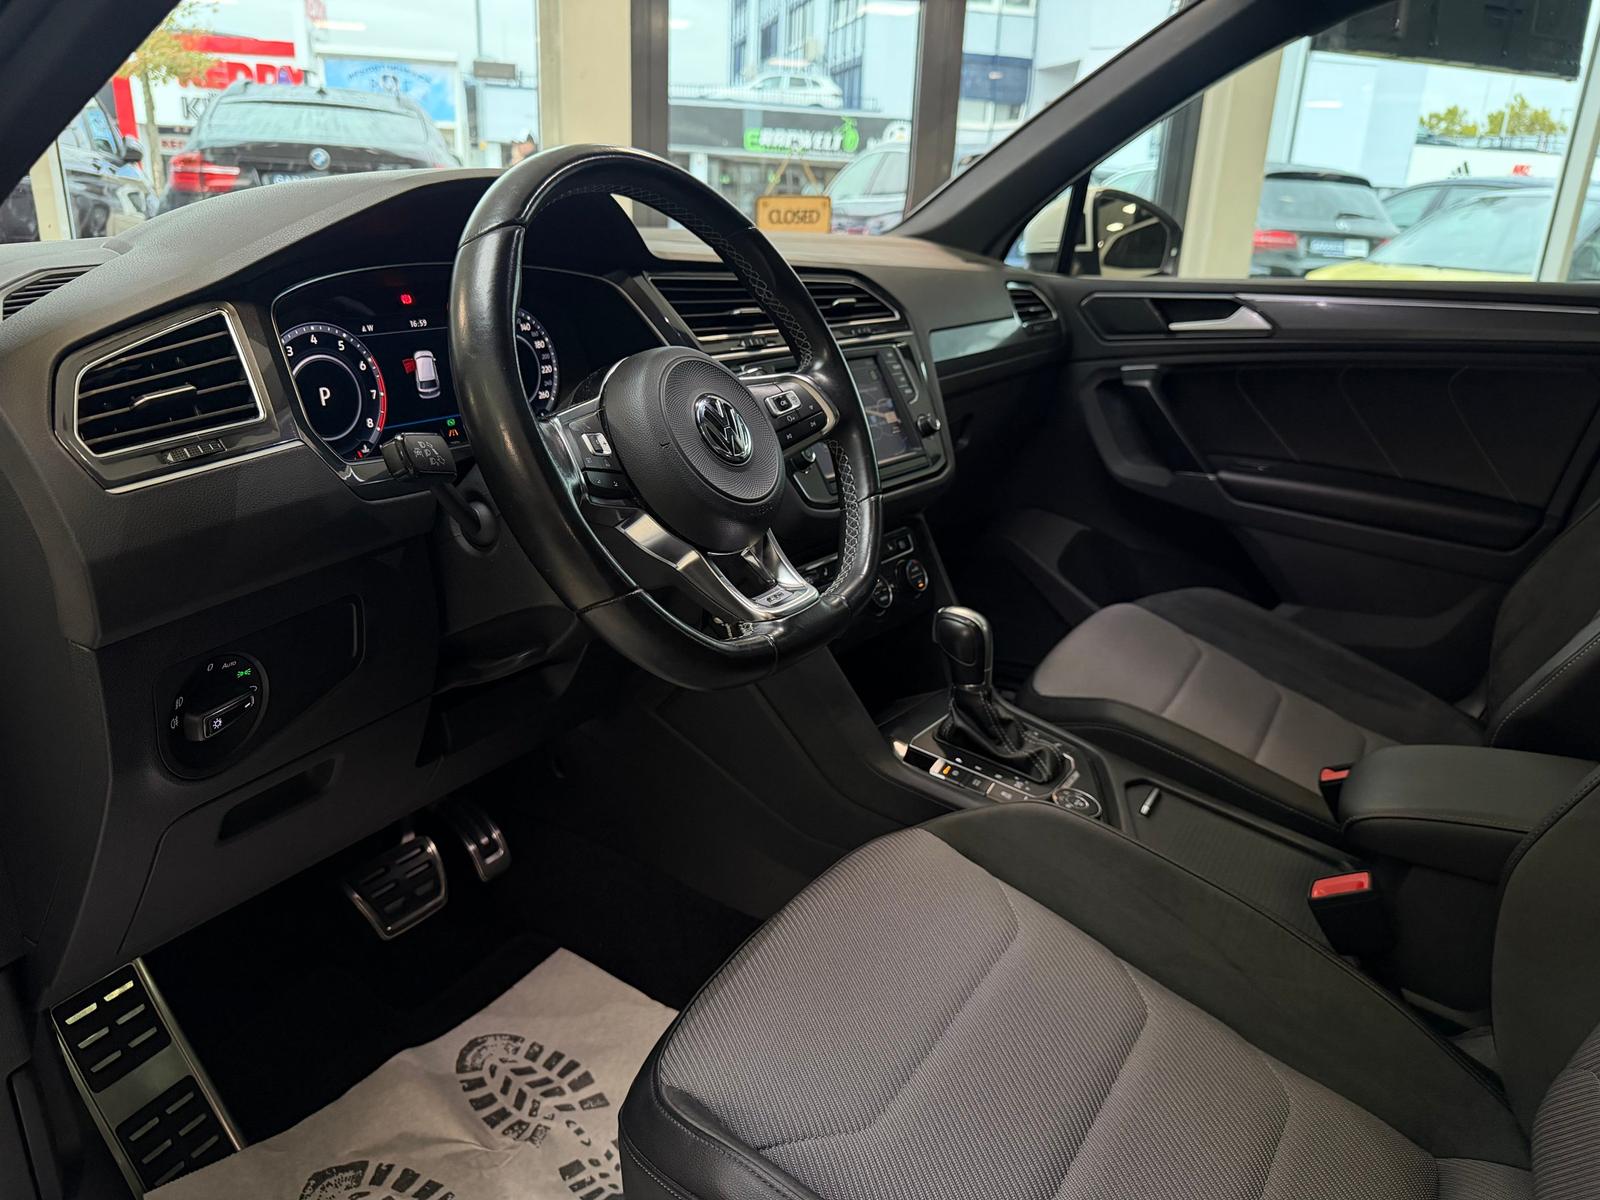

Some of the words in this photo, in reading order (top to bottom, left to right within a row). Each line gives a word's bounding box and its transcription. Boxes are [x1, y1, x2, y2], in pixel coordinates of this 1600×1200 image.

[768, 208, 821, 225] CLOSED
[409, 319, 428, 328] 16:59
[520, 323, 531, 332] 140
[310, 334, 318, 345] 4
[534, 340, 545, 349] 180
[337, 340, 345, 351] 5
[286, 345, 294, 357] 3
[360, 361, 367, 370] 6
[541, 365, 552, 374] 220
[319, 386, 331, 407] P
[370, 389, 377, 400] 7
[538, 390, 550, 399] 260
[366, 417, 375, 429] 8
[222, 661, 236, 669] Auto
